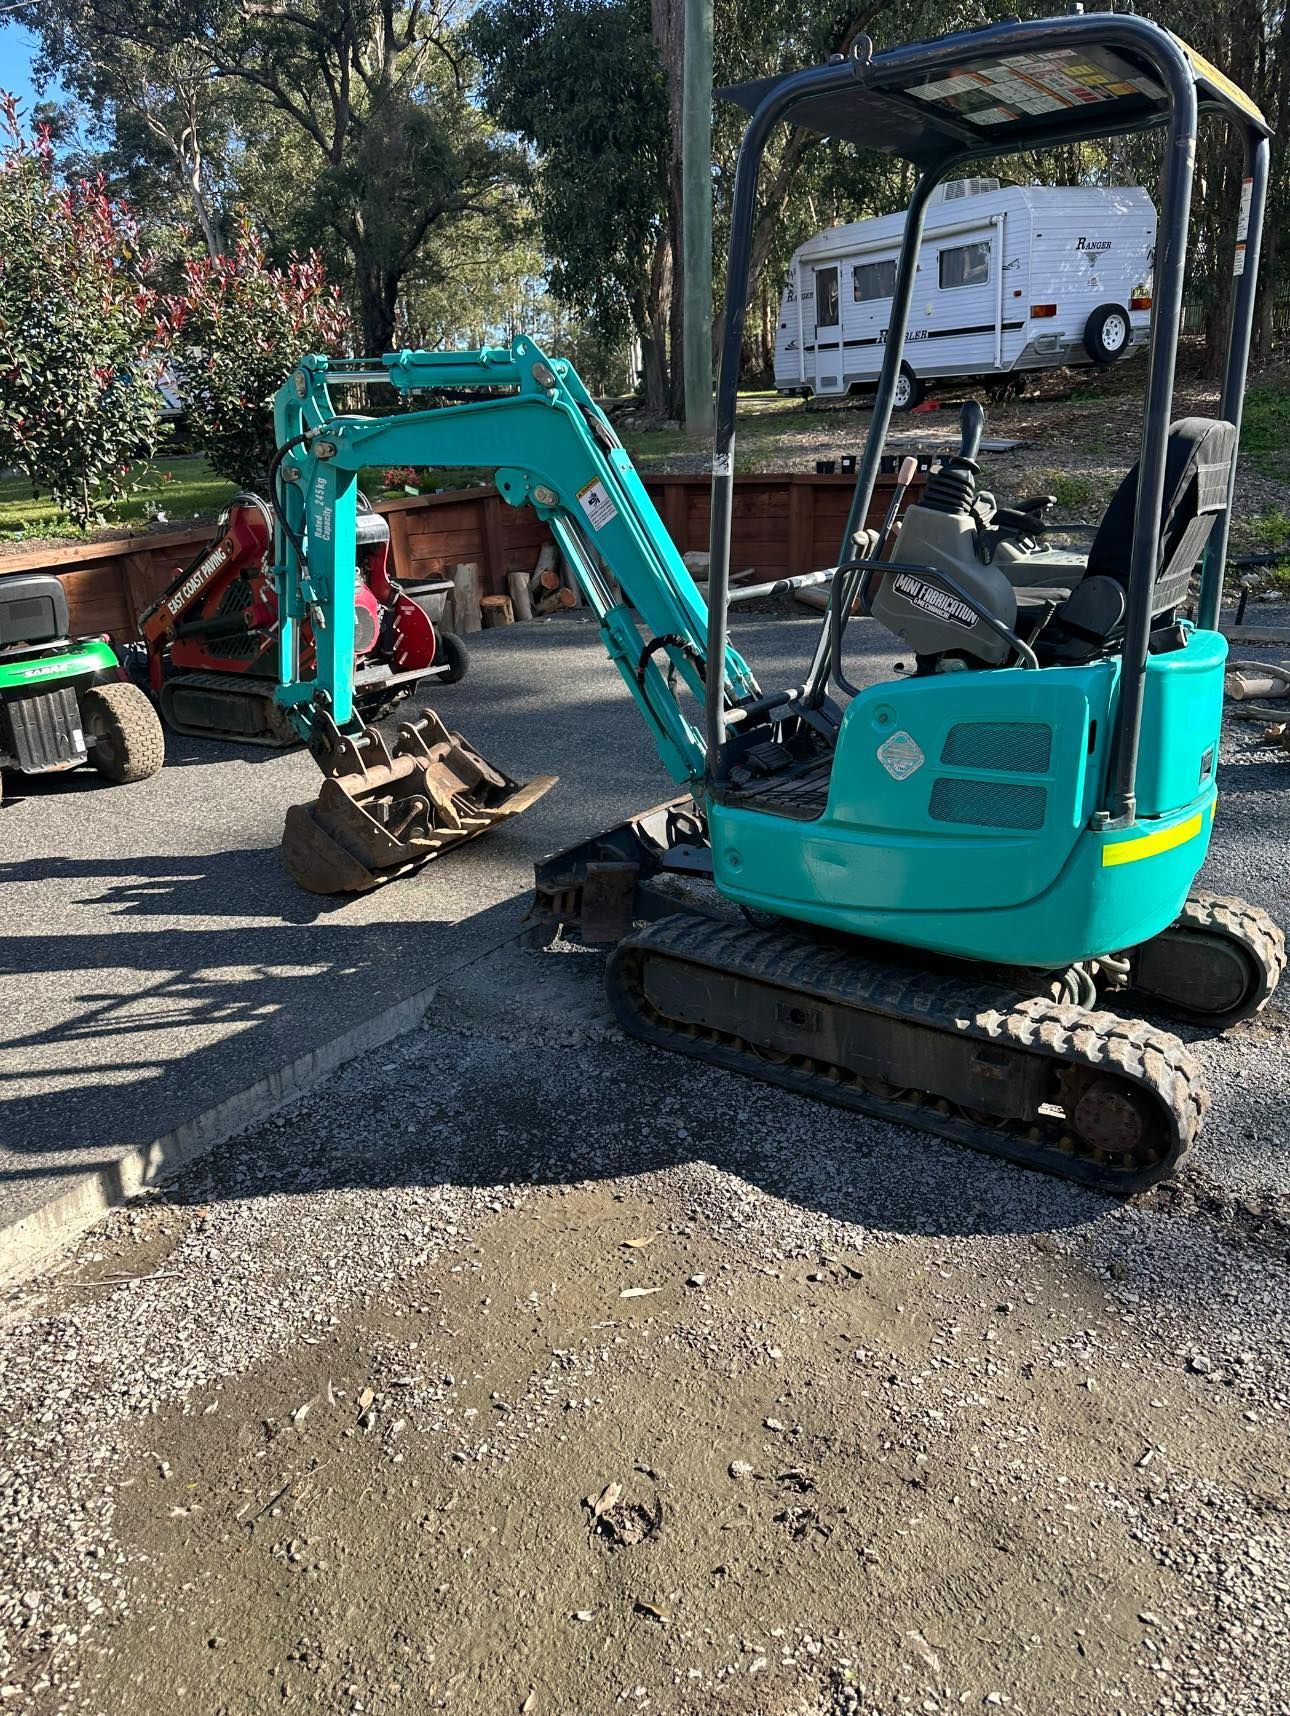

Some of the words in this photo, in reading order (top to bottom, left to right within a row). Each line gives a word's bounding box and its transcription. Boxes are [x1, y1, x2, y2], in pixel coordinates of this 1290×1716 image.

[1076, 237, 1112, 250] RANGER
[315, 477, 327, 506] 245kg
[314, 514, 323, 538] Rated
[323, 505, 333, 540] Capacity
[168, 591, 185, 615] EAST
[182, 570, 204, 598] COAST
[201, 547, 227, 578] PAVING
[896, 573, 922, 596] MINI
[918, 585, 978, 624] FABRICATION
